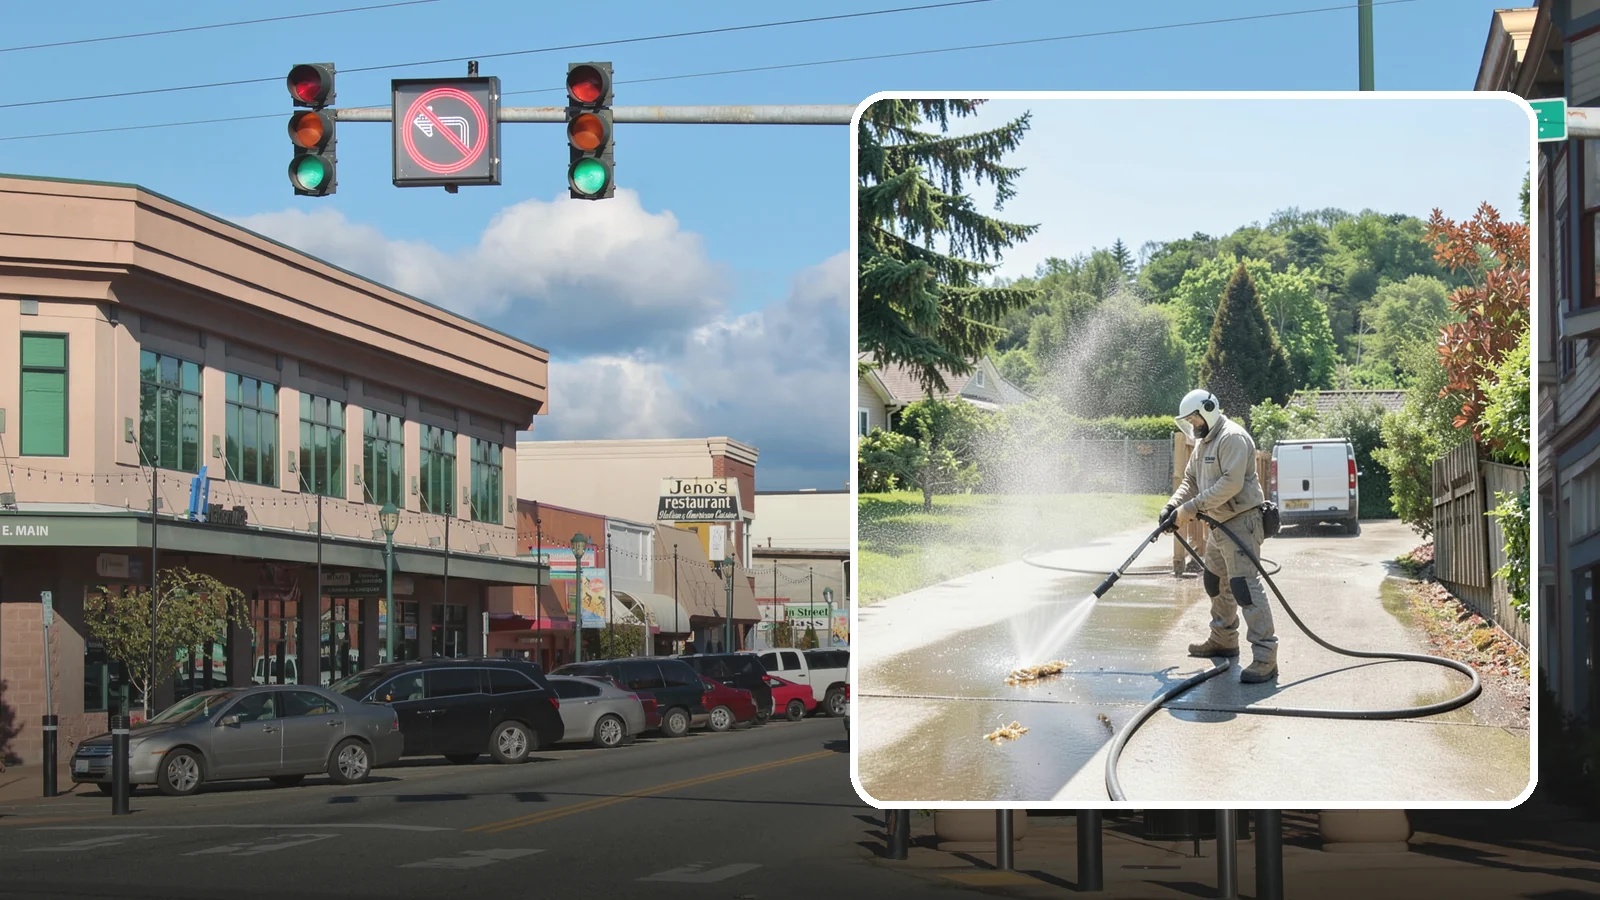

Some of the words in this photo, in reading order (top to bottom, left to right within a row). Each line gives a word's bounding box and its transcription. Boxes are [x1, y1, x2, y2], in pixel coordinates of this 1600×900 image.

[669, 480, 728, 495] Jeno's
[665, 496, 731, 509] restaurant
[658, 510, 681, 519] Italian
[686, 509, 715, 519] American
[715, 509, 738, 519] Cuisine
[2, 525, 13, 536] E.
[15, 525, 49, 536] MAIN
[797, 607, 829, 617] Street
[790, 619, 824, 627] lass
